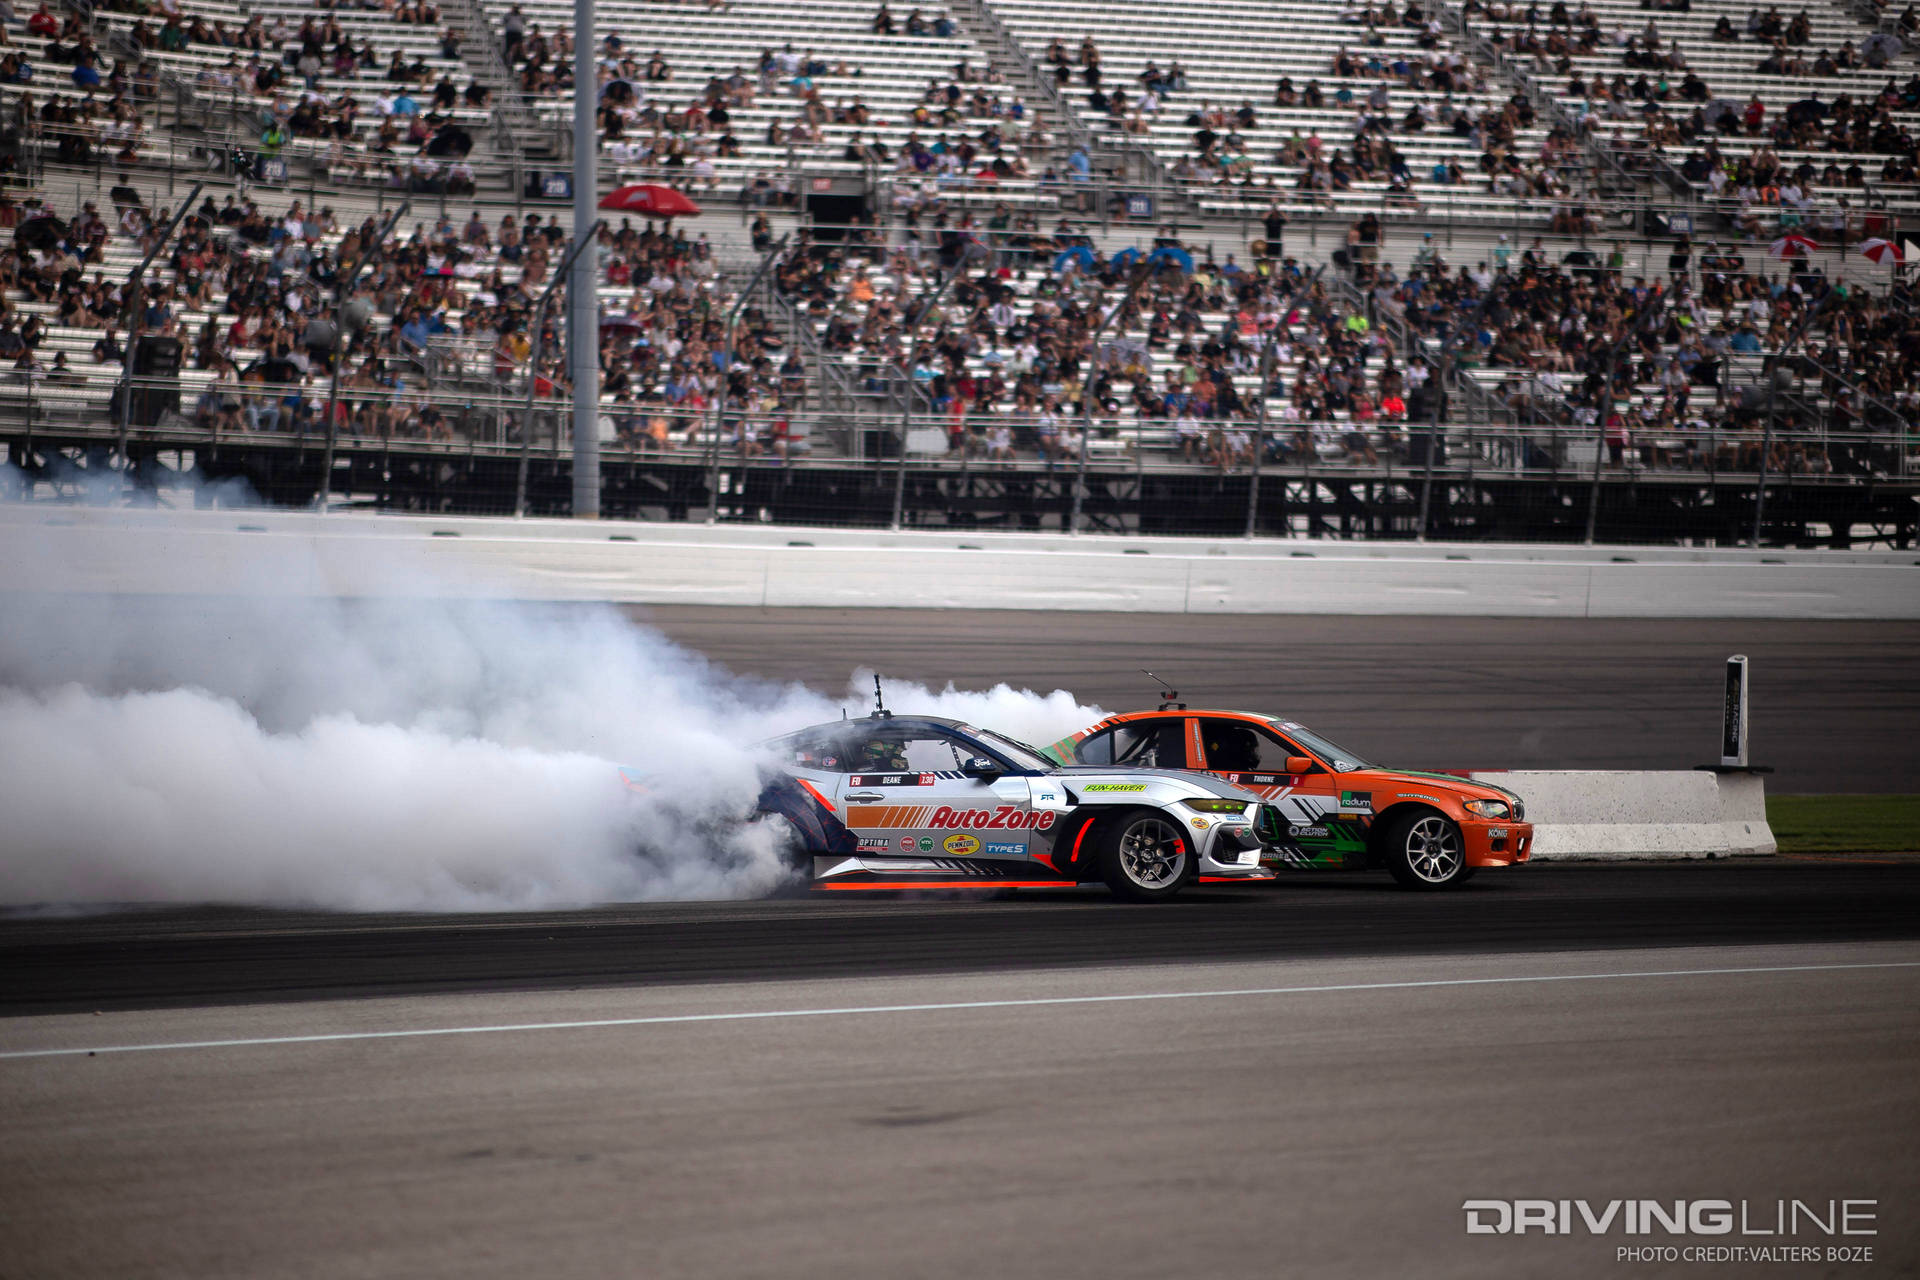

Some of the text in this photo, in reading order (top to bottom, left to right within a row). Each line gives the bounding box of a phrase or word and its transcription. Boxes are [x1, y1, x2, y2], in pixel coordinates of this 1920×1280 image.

[974, 758, 991, 767] Ford
[851, 775, 934, 786] FD DEANE 130
[1253, 775, 1275, 783] THORNE
[1085, 784, 1146, 792] FUN-HAVER
[928, 806, 1055, 829] AutoZone
[859, 838, 889, 847] OPTIMA
[947, 840, 976, 849] PENNZOIL
